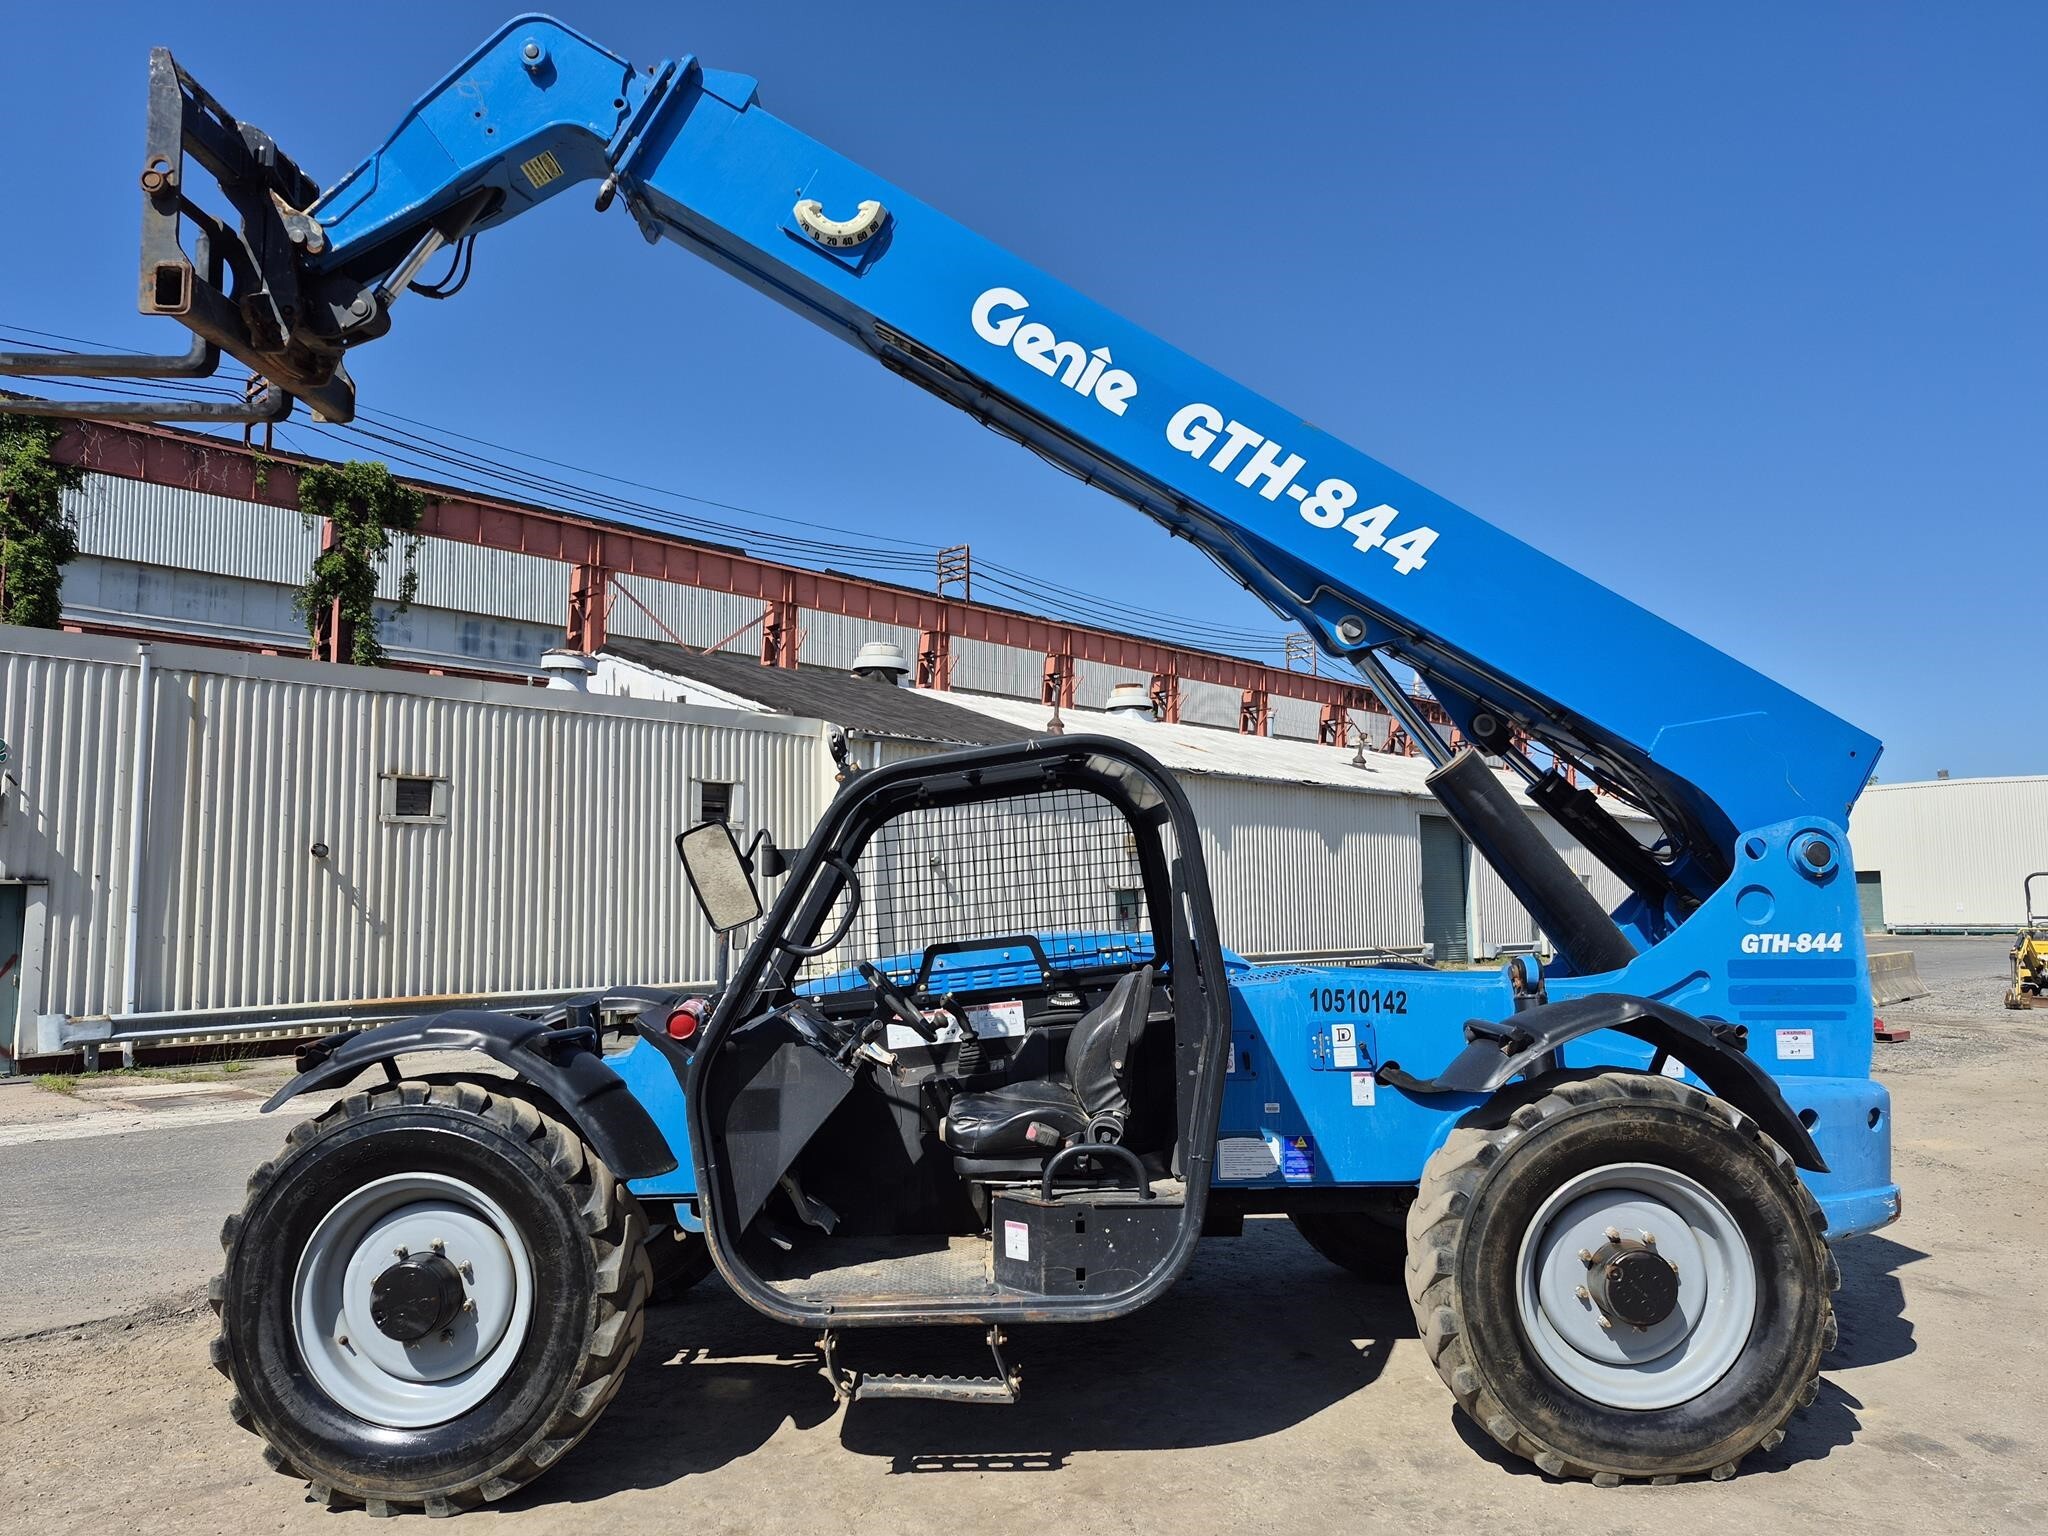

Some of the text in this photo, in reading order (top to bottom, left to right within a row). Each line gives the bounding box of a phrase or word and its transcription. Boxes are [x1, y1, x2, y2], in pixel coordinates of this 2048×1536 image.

[815, 231, 820, 241] 0
[827, 236, 838, 246] 20
[842, 236, 854, 246] 40
[857, 230, 868, 242] 60
[869, 220, 880, 233] 80
[970, 286, 1440, 576] Genie GTH-844
[1741, 932, 1843, 954] GTH-844
[1309, 987, 1408, 1015] 10510142
